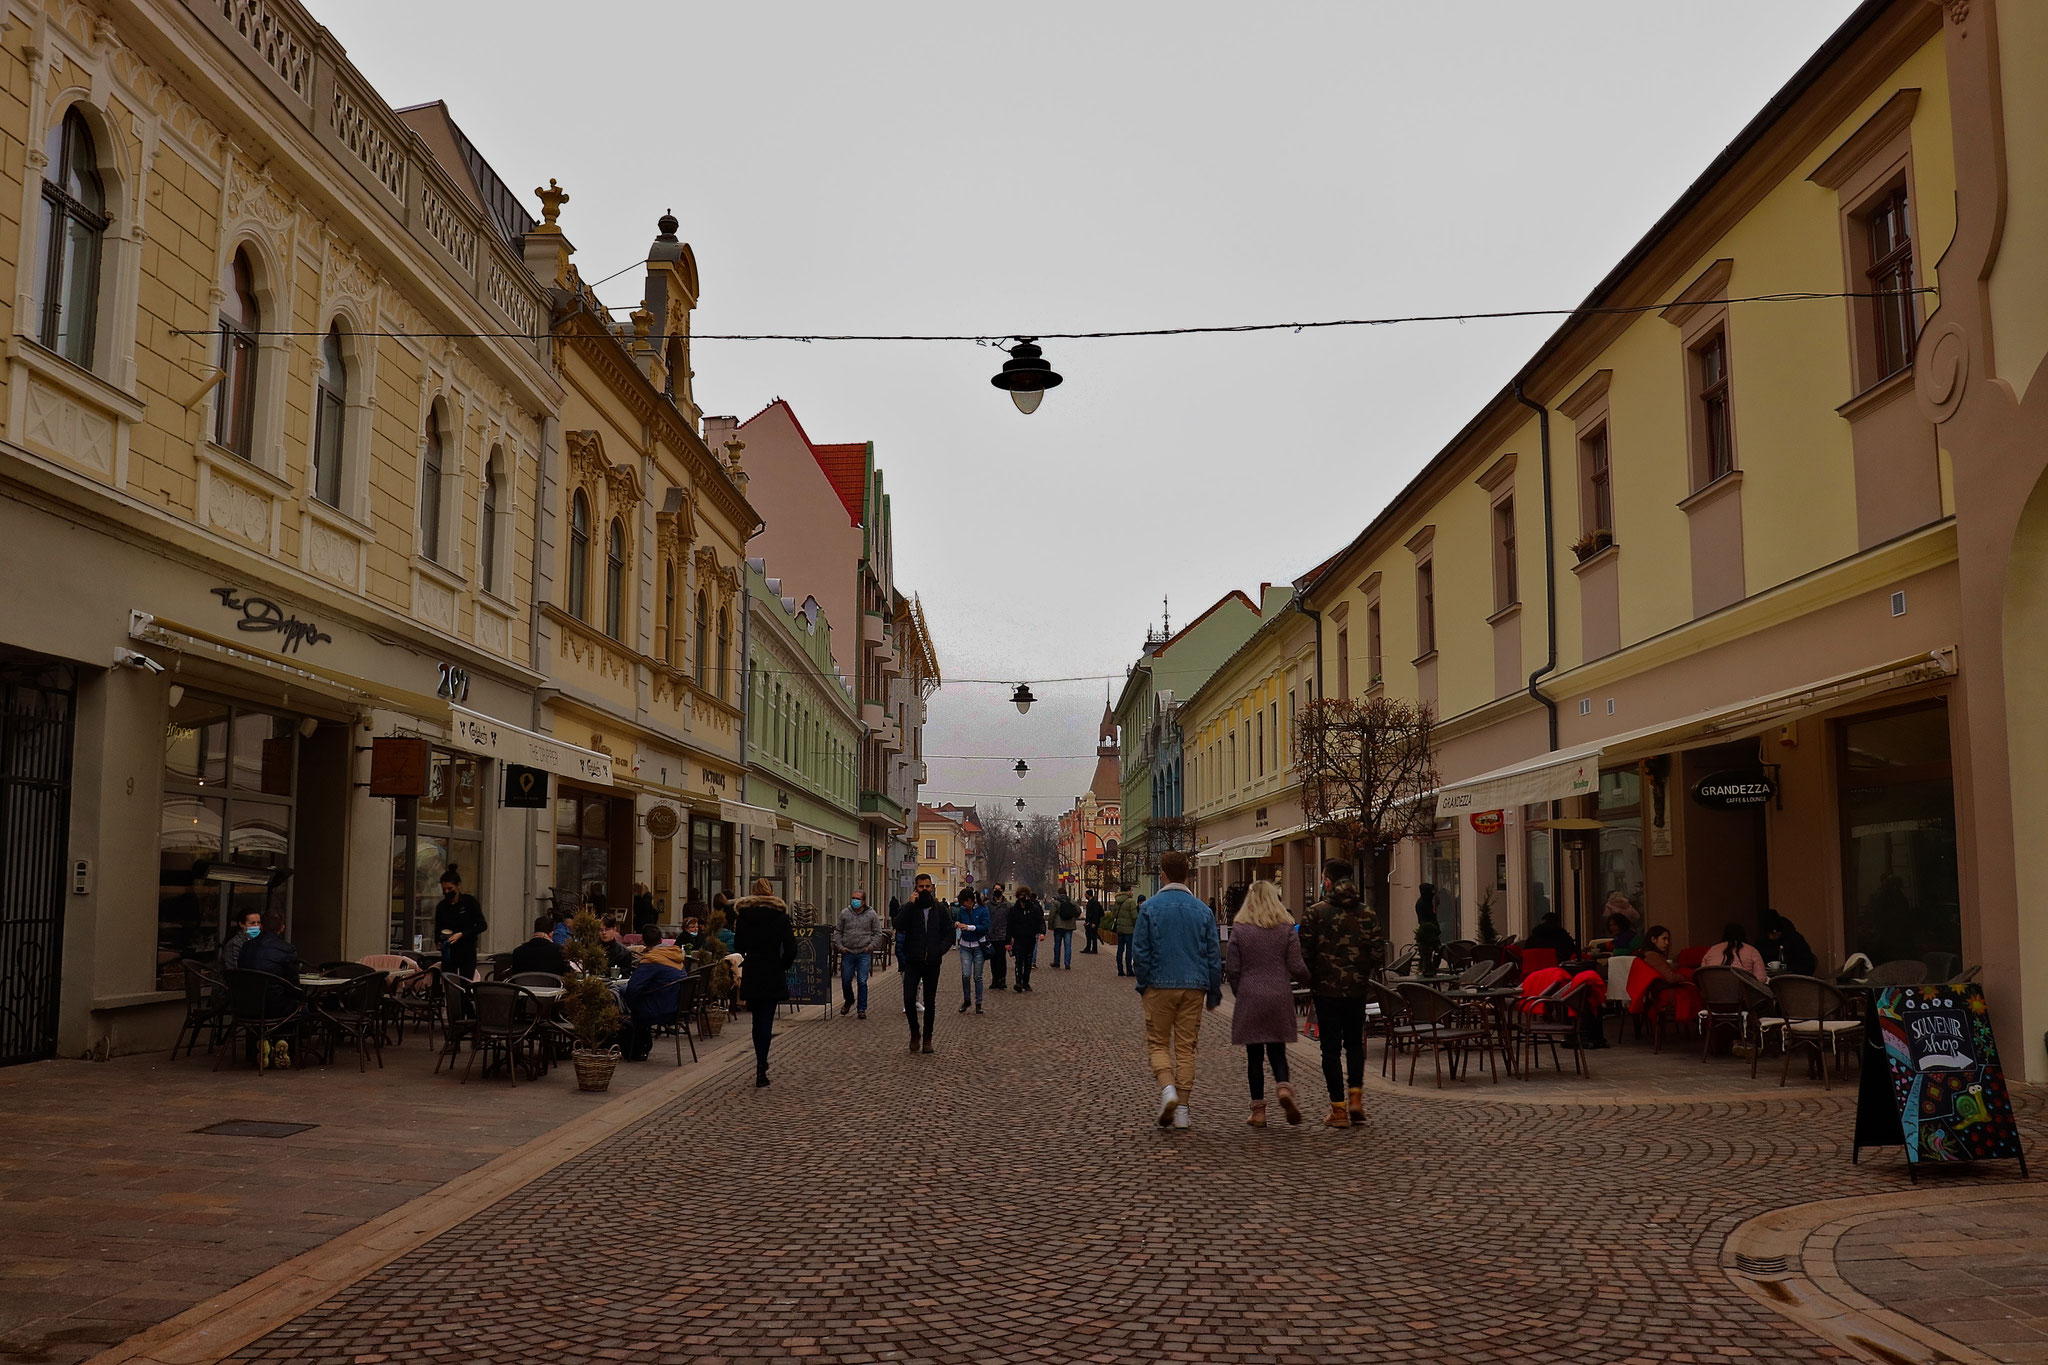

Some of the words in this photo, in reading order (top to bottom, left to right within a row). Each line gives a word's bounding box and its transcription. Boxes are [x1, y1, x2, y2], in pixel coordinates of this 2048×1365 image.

[238, 598, 332, 653] Dripper
[126, 776, 134, 796] 9
[1701, 783, 1770, 796] GRANDEZZA
[1442, 794, 1472, 809] GRANDEZZA
[1911, 1016, 1964, 1039] SOUVENIR
[1922, 1033, 1959, 1057] shop
